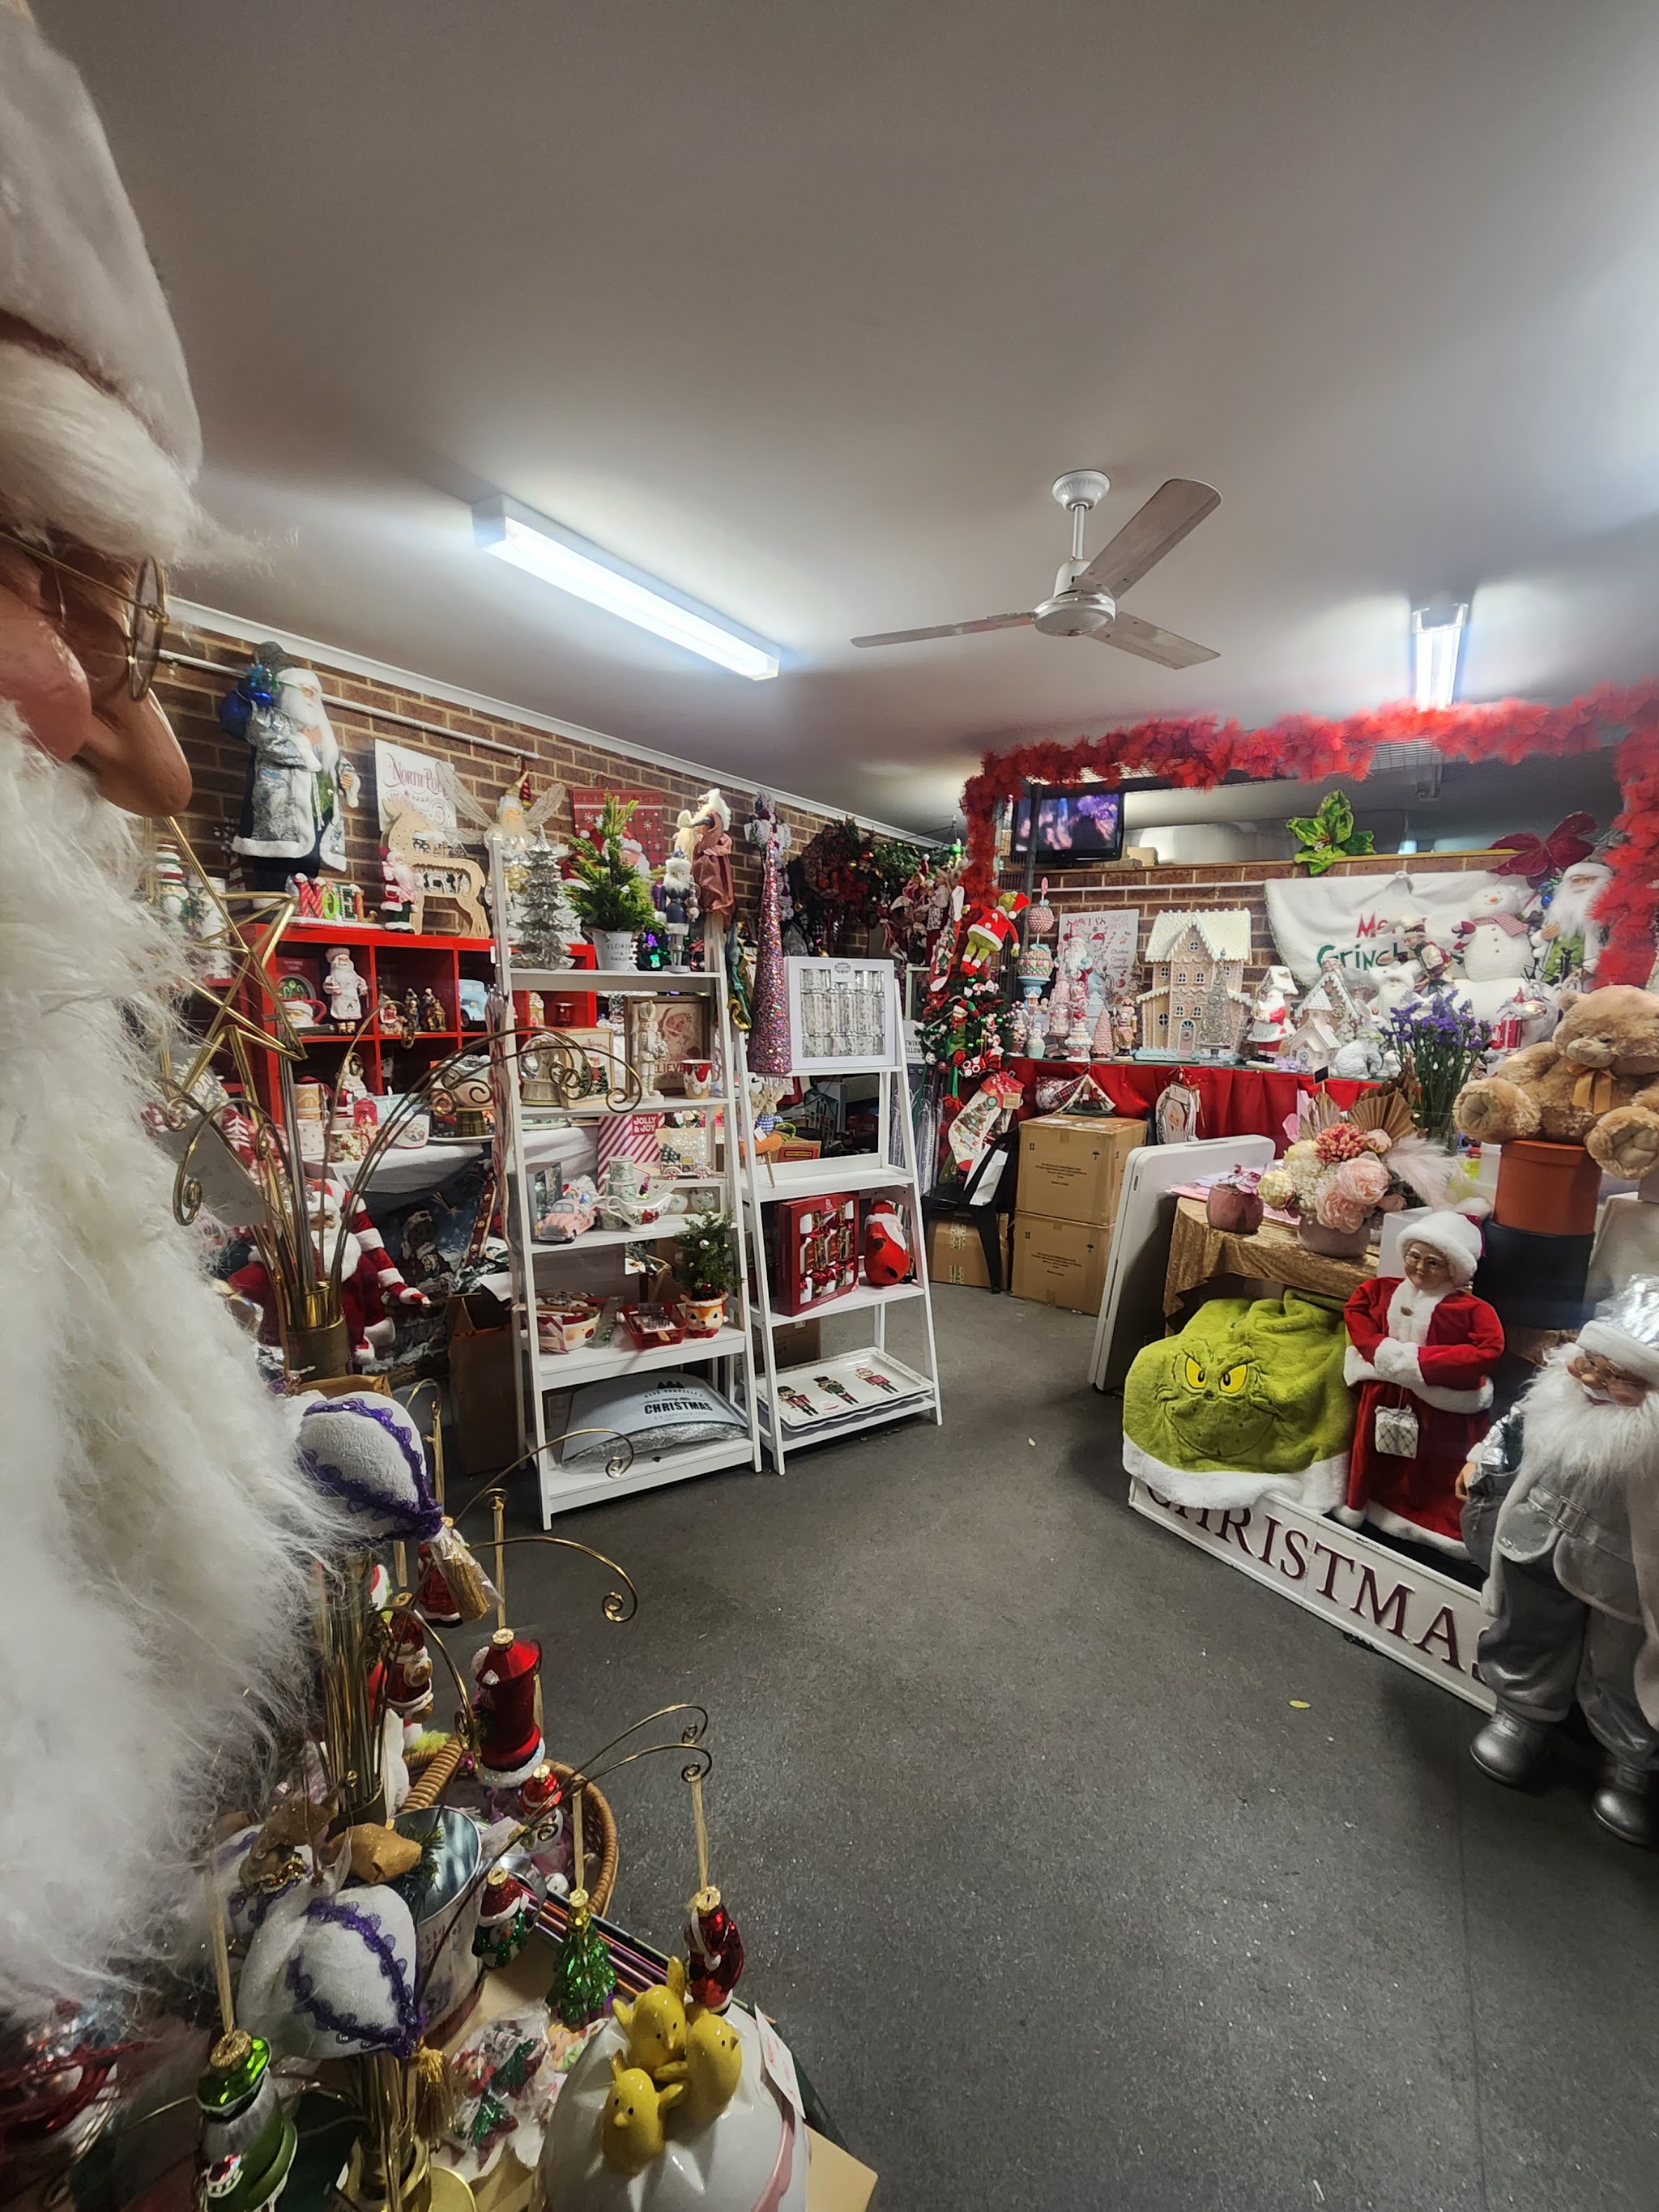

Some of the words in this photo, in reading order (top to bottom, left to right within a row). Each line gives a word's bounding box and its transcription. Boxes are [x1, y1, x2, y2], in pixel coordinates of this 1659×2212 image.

[293, 872, 377, 923] NOEL
[633, 1116, 657, 1126] JOLLY
[640, 1124, 656, 1133] JOY
[644, 1401, 713, 1415] CHRISTMAS
